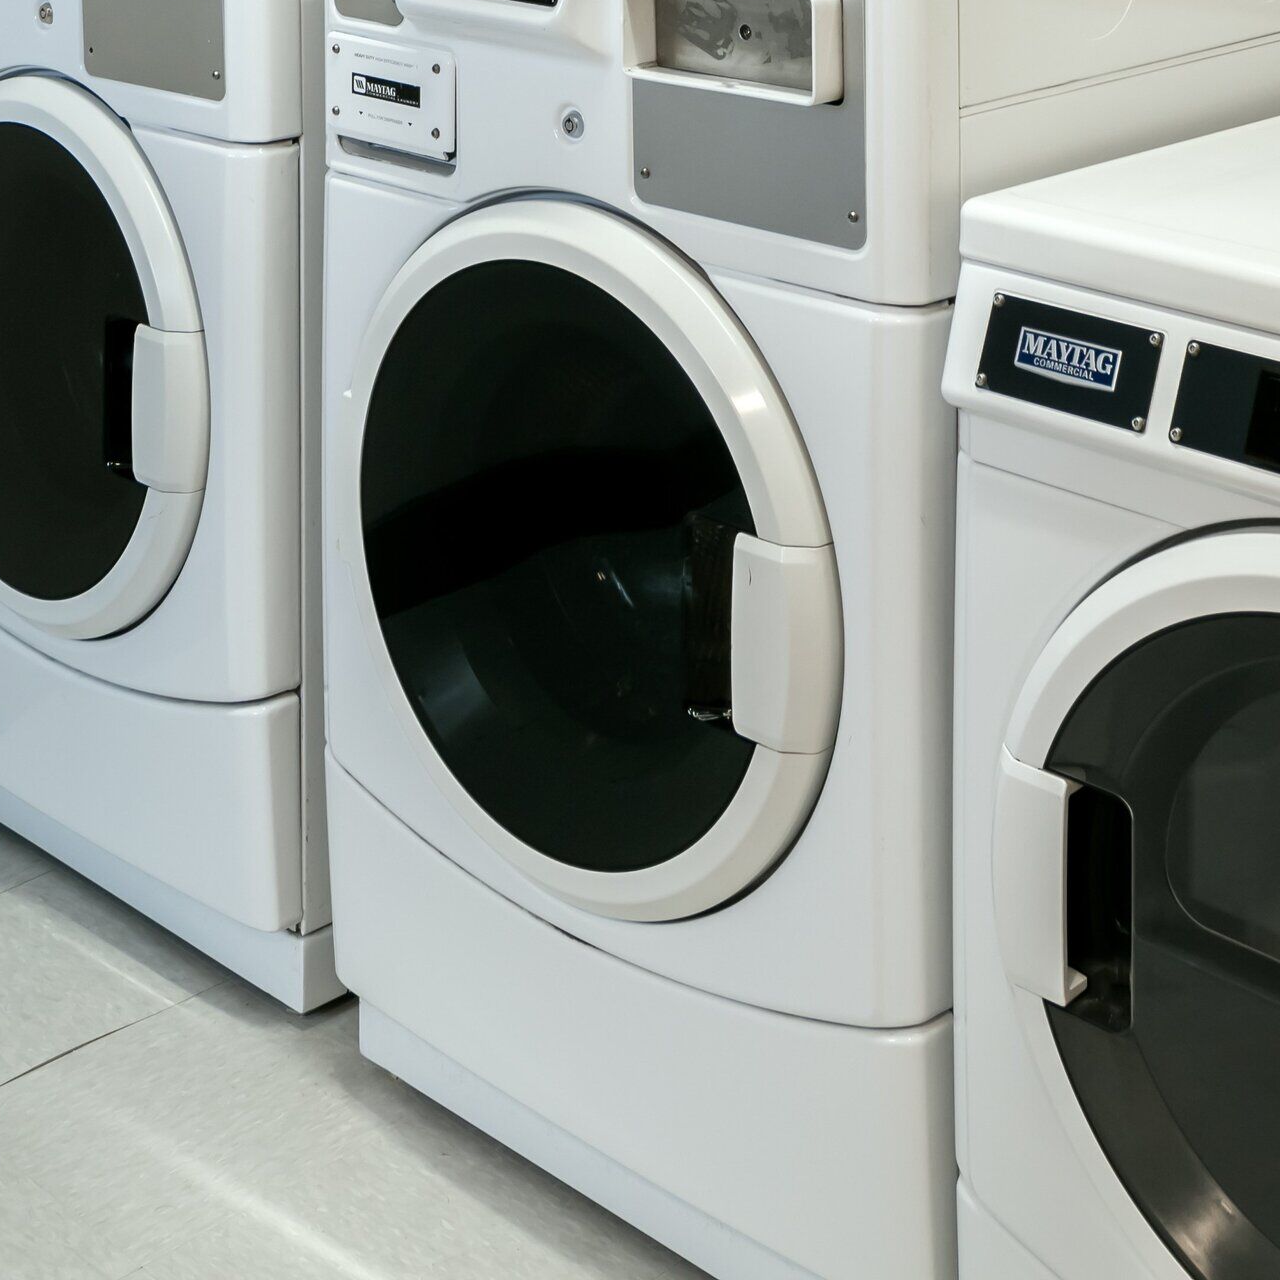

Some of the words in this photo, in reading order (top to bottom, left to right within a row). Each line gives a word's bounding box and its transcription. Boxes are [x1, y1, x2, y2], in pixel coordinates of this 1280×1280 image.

[366, 81, 397, 97] MAYTAG
[1022, 332, 1113, 375] MAYTAG
[1033, 357, 1094, 381] COMMERCIAL
